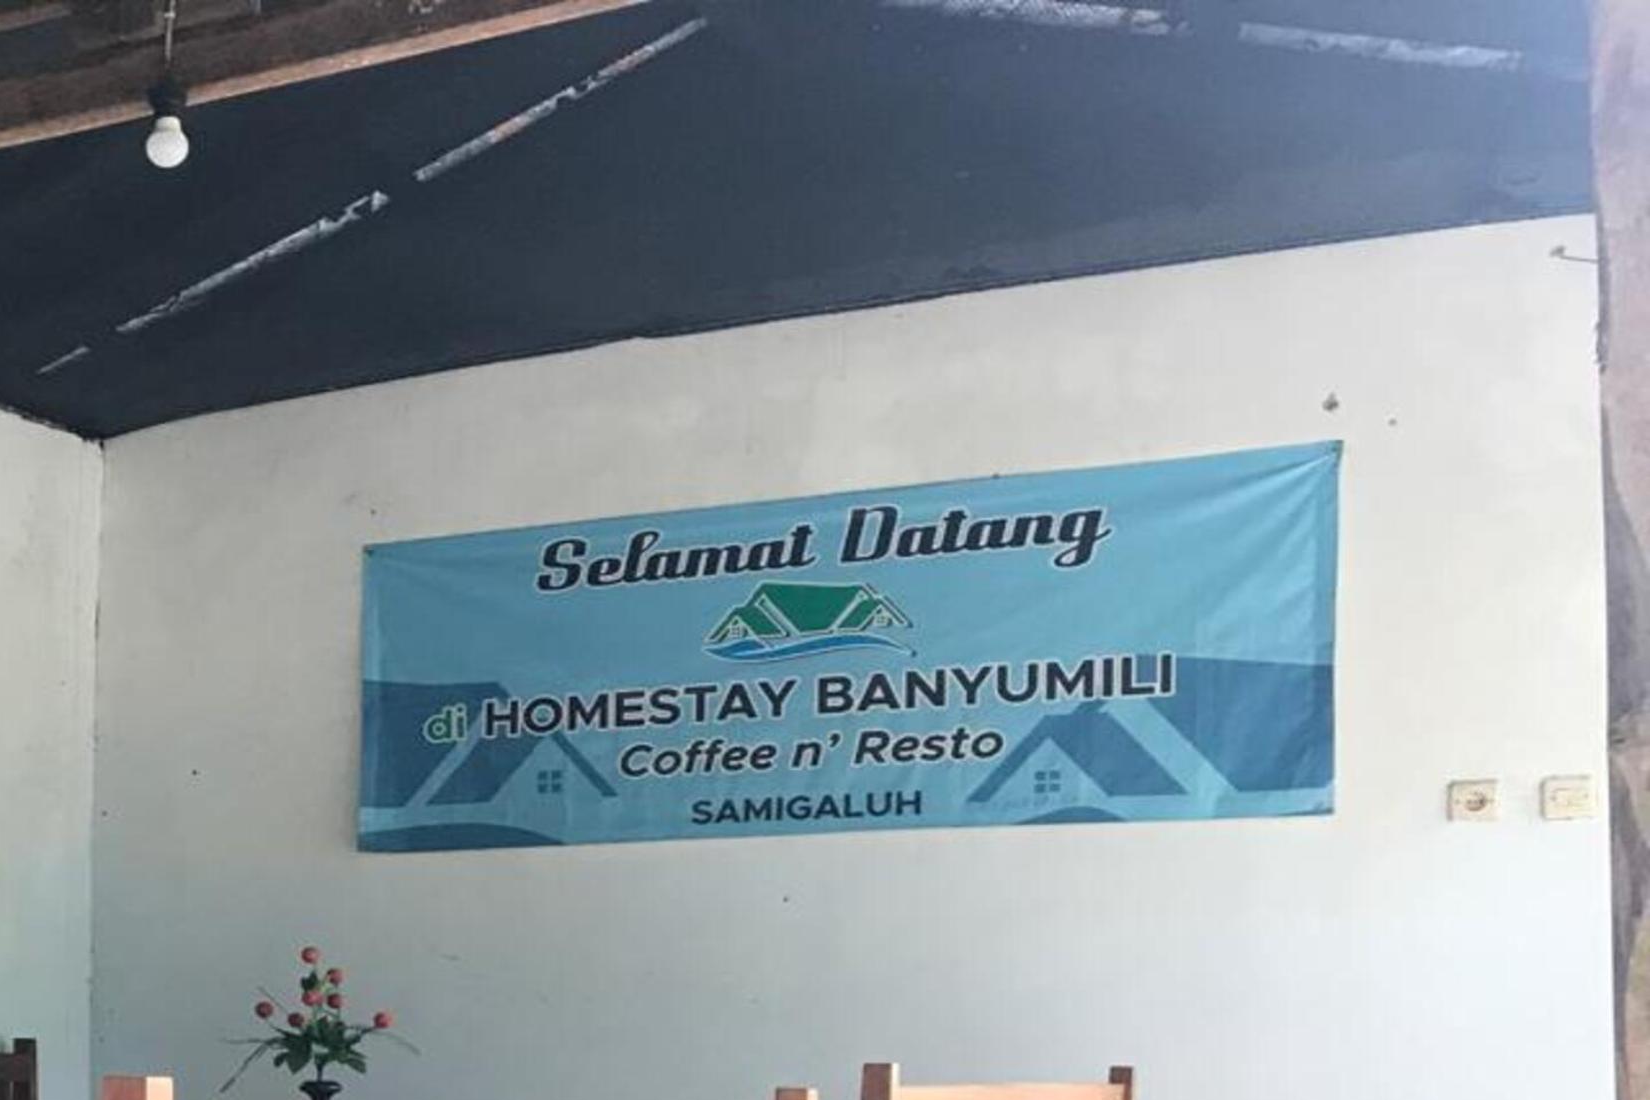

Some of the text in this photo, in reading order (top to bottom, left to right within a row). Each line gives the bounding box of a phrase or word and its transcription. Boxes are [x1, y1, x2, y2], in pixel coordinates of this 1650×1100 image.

[537, 505, 1112, 592] Selamat Datang
[425, 654, 1173, 742] di HOMESTAY BANYUMILI
[620, 740, 776, 777] Coffee
[853, 726, 1004, 765] Resto
[691, 790, 922, 824] SAMIGALUH
